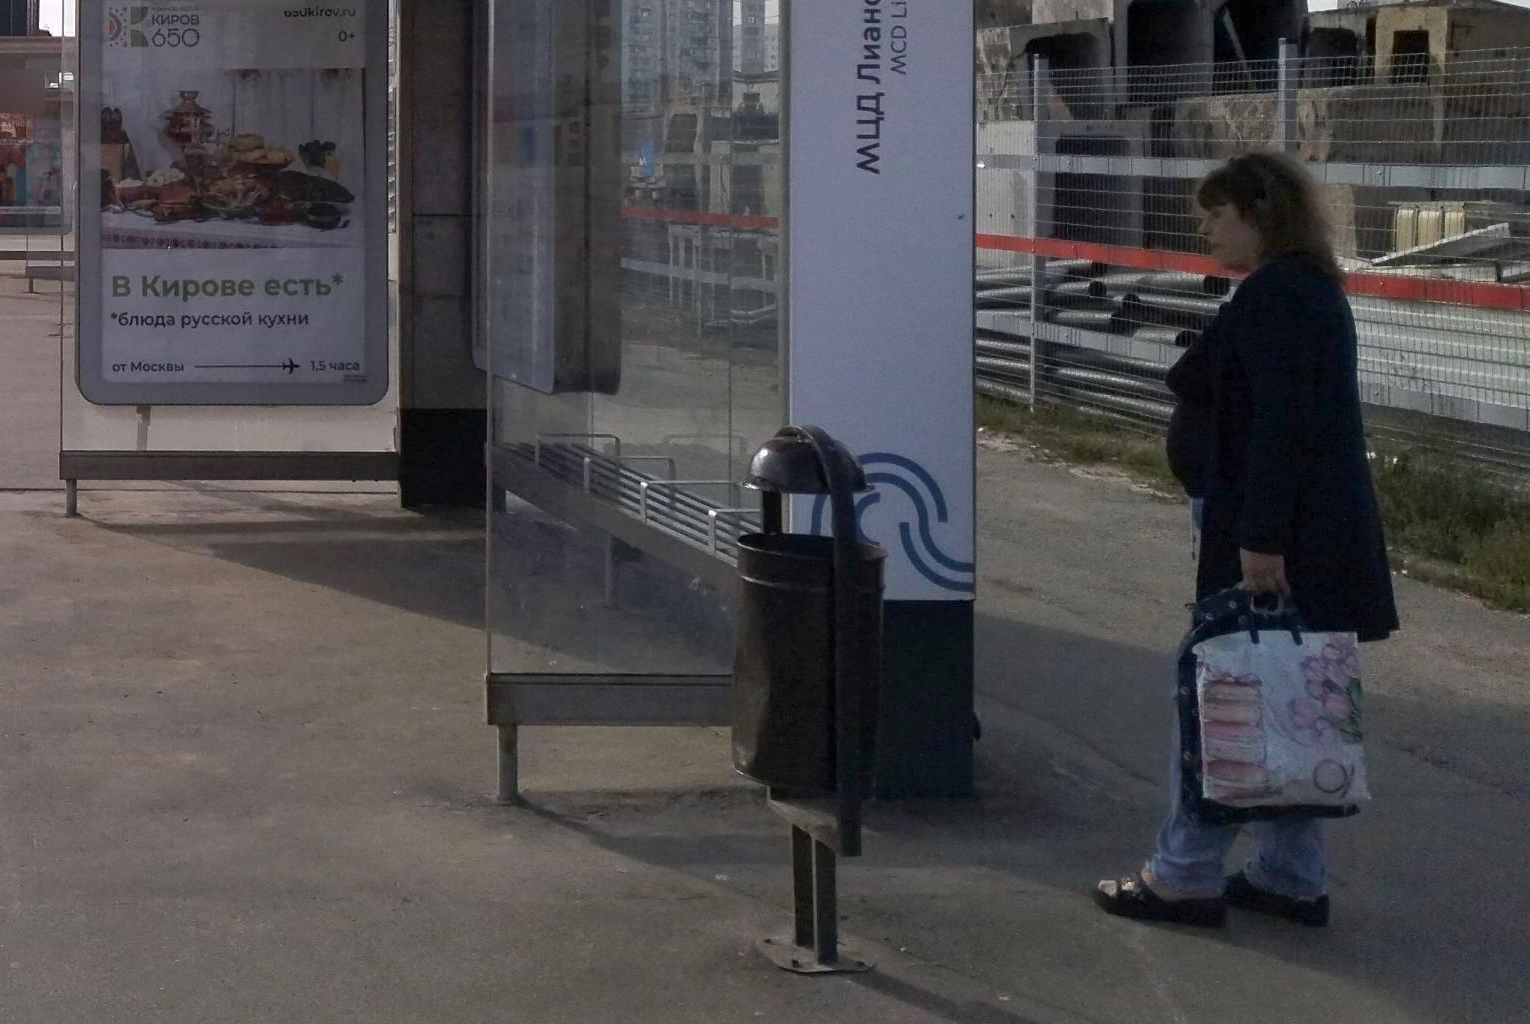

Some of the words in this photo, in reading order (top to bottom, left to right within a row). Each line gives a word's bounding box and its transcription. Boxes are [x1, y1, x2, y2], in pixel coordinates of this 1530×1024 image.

[151, 14, 200, 26] КИРОВ
[151, 28, 200, 47] 650
[338, 30, 357, 42] 0+
[891, 25, 908, 76] MCD
[856, 91, 885, 175] МЦД
[112, 275, 131, 297] В
[141, 275, 255, 303] Кирове
[181, 312, 253, 329] русской
[258, 314, 310, 329] кухни
[112, 363, 127, 373] от
[130, 361, 185, 373] Москвы
[328, 361, 361, 372] часа
